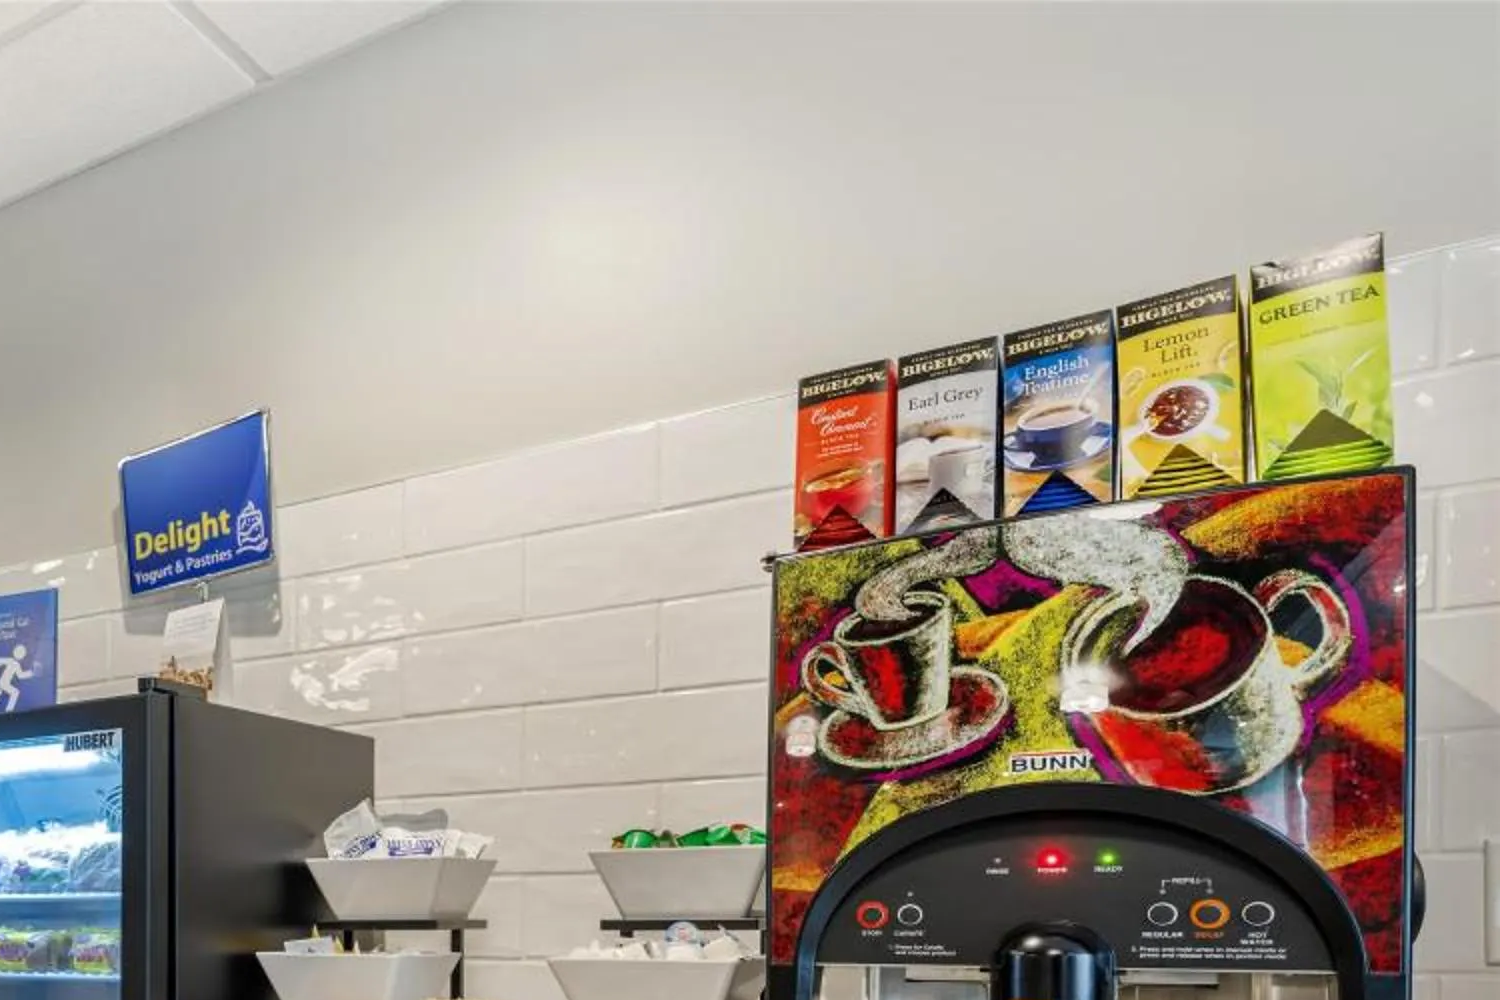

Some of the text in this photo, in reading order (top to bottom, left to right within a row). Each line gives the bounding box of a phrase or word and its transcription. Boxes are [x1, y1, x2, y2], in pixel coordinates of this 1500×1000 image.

[1121, 290, 1228, 327] BIGELOW
[1259, 284, 1380, 325] GREEN TEA
[1008, 323, 1104, 355] BIGELOW
[1143, 327, 1209, 352] Lemon
[902, 349, 991, 378] BIGELOW
[1025, 355, 1089, 380] English
[802, 371, 883, 398] BIGELOW
[1023, 374, 1089, 395] Teatime
[908, 386, 983, 411] Earl Grey
[135, 510, 231, 560] Delight
[135, 549, 233, 585] Yogurt & Pastries
[64, 731, 116, 752] HUBERT
[1011, 755, 1087, 773] BUNN
